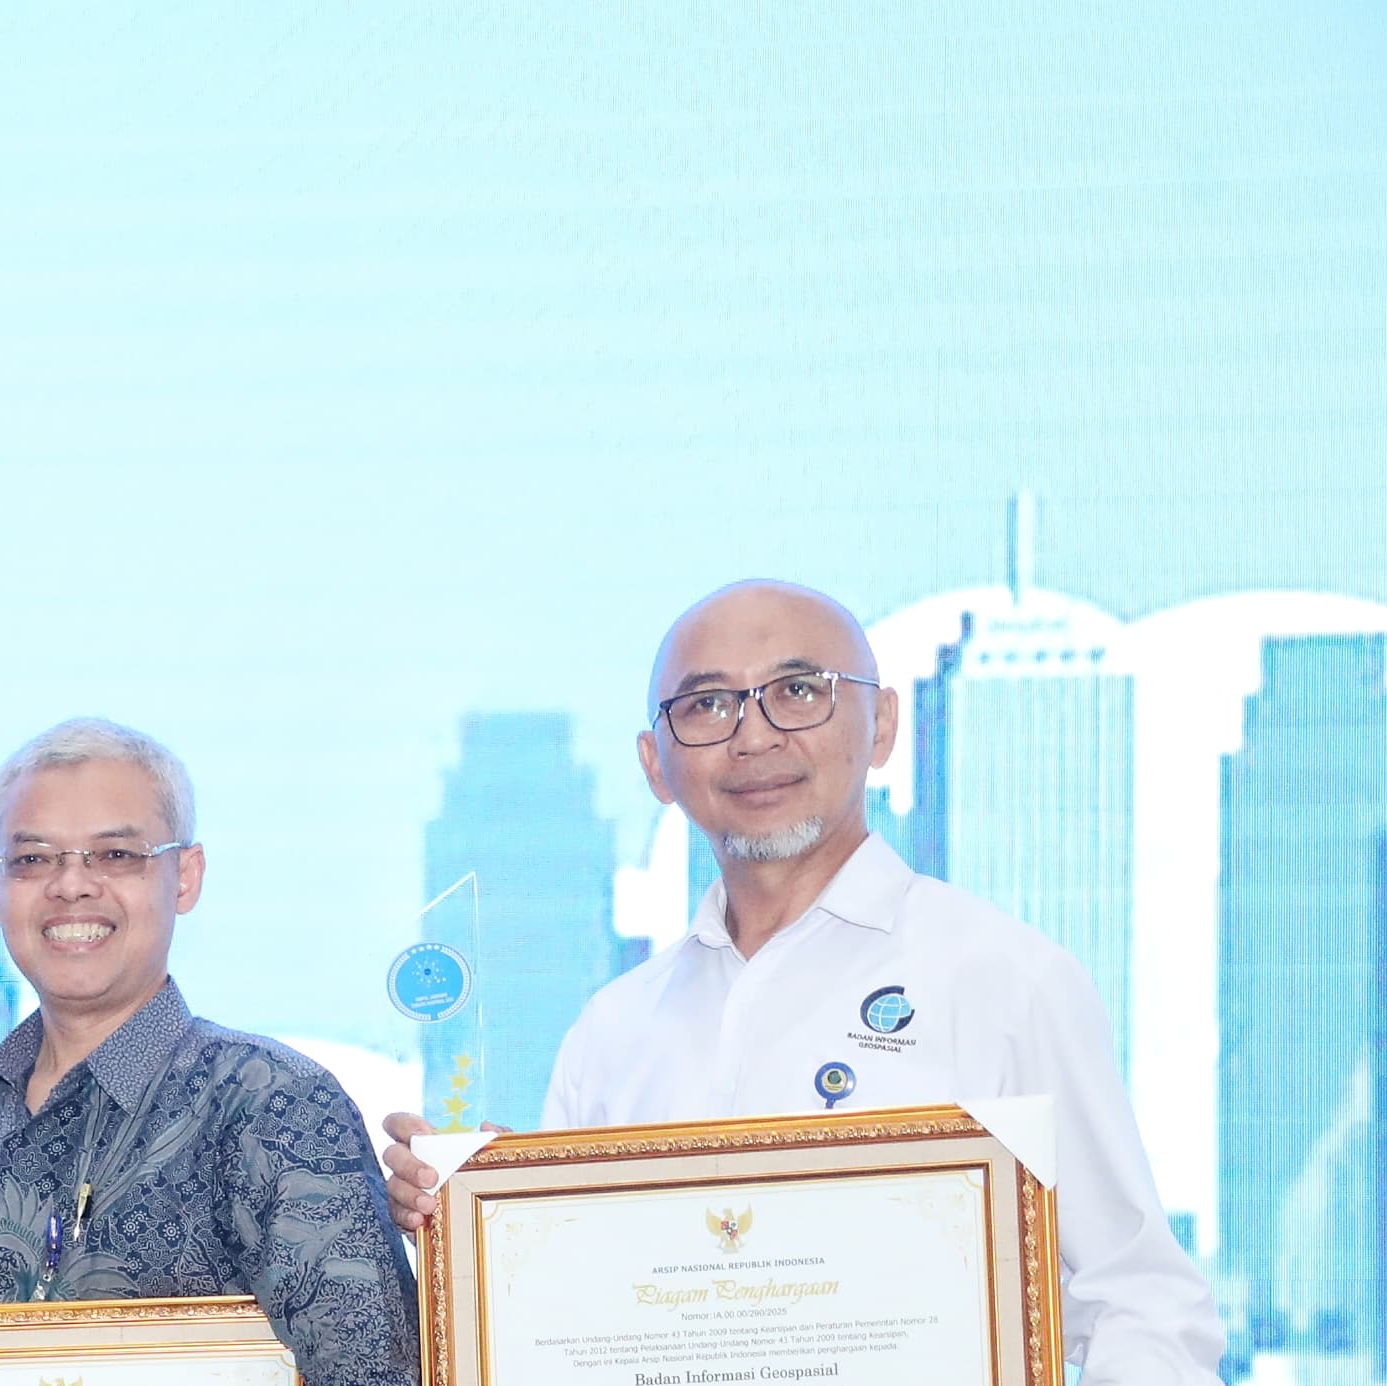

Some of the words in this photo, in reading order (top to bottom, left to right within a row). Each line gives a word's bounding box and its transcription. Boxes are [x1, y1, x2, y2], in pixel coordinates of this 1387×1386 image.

[847, 1032, 873, 1042] BADAN
[875, 1036, 917, 1046] INFORMASI
[651, 1265, 679, 1274] ARSIP
[681, 1263, 726, 1273] NASIONAL
[728, 1260, 772, 1270] REPUBLIK
[774, 1257, 825, 1268] INDONESIA
[632, 1283, 709, 1311] Piagam
[711, 1277, 839, 1307] Penghargaan
[634, 1372, 681, 1386] Badan
[686, 1367, 755, 1384] Informasi
[760, 1362, 838, 1381] Geospasial
